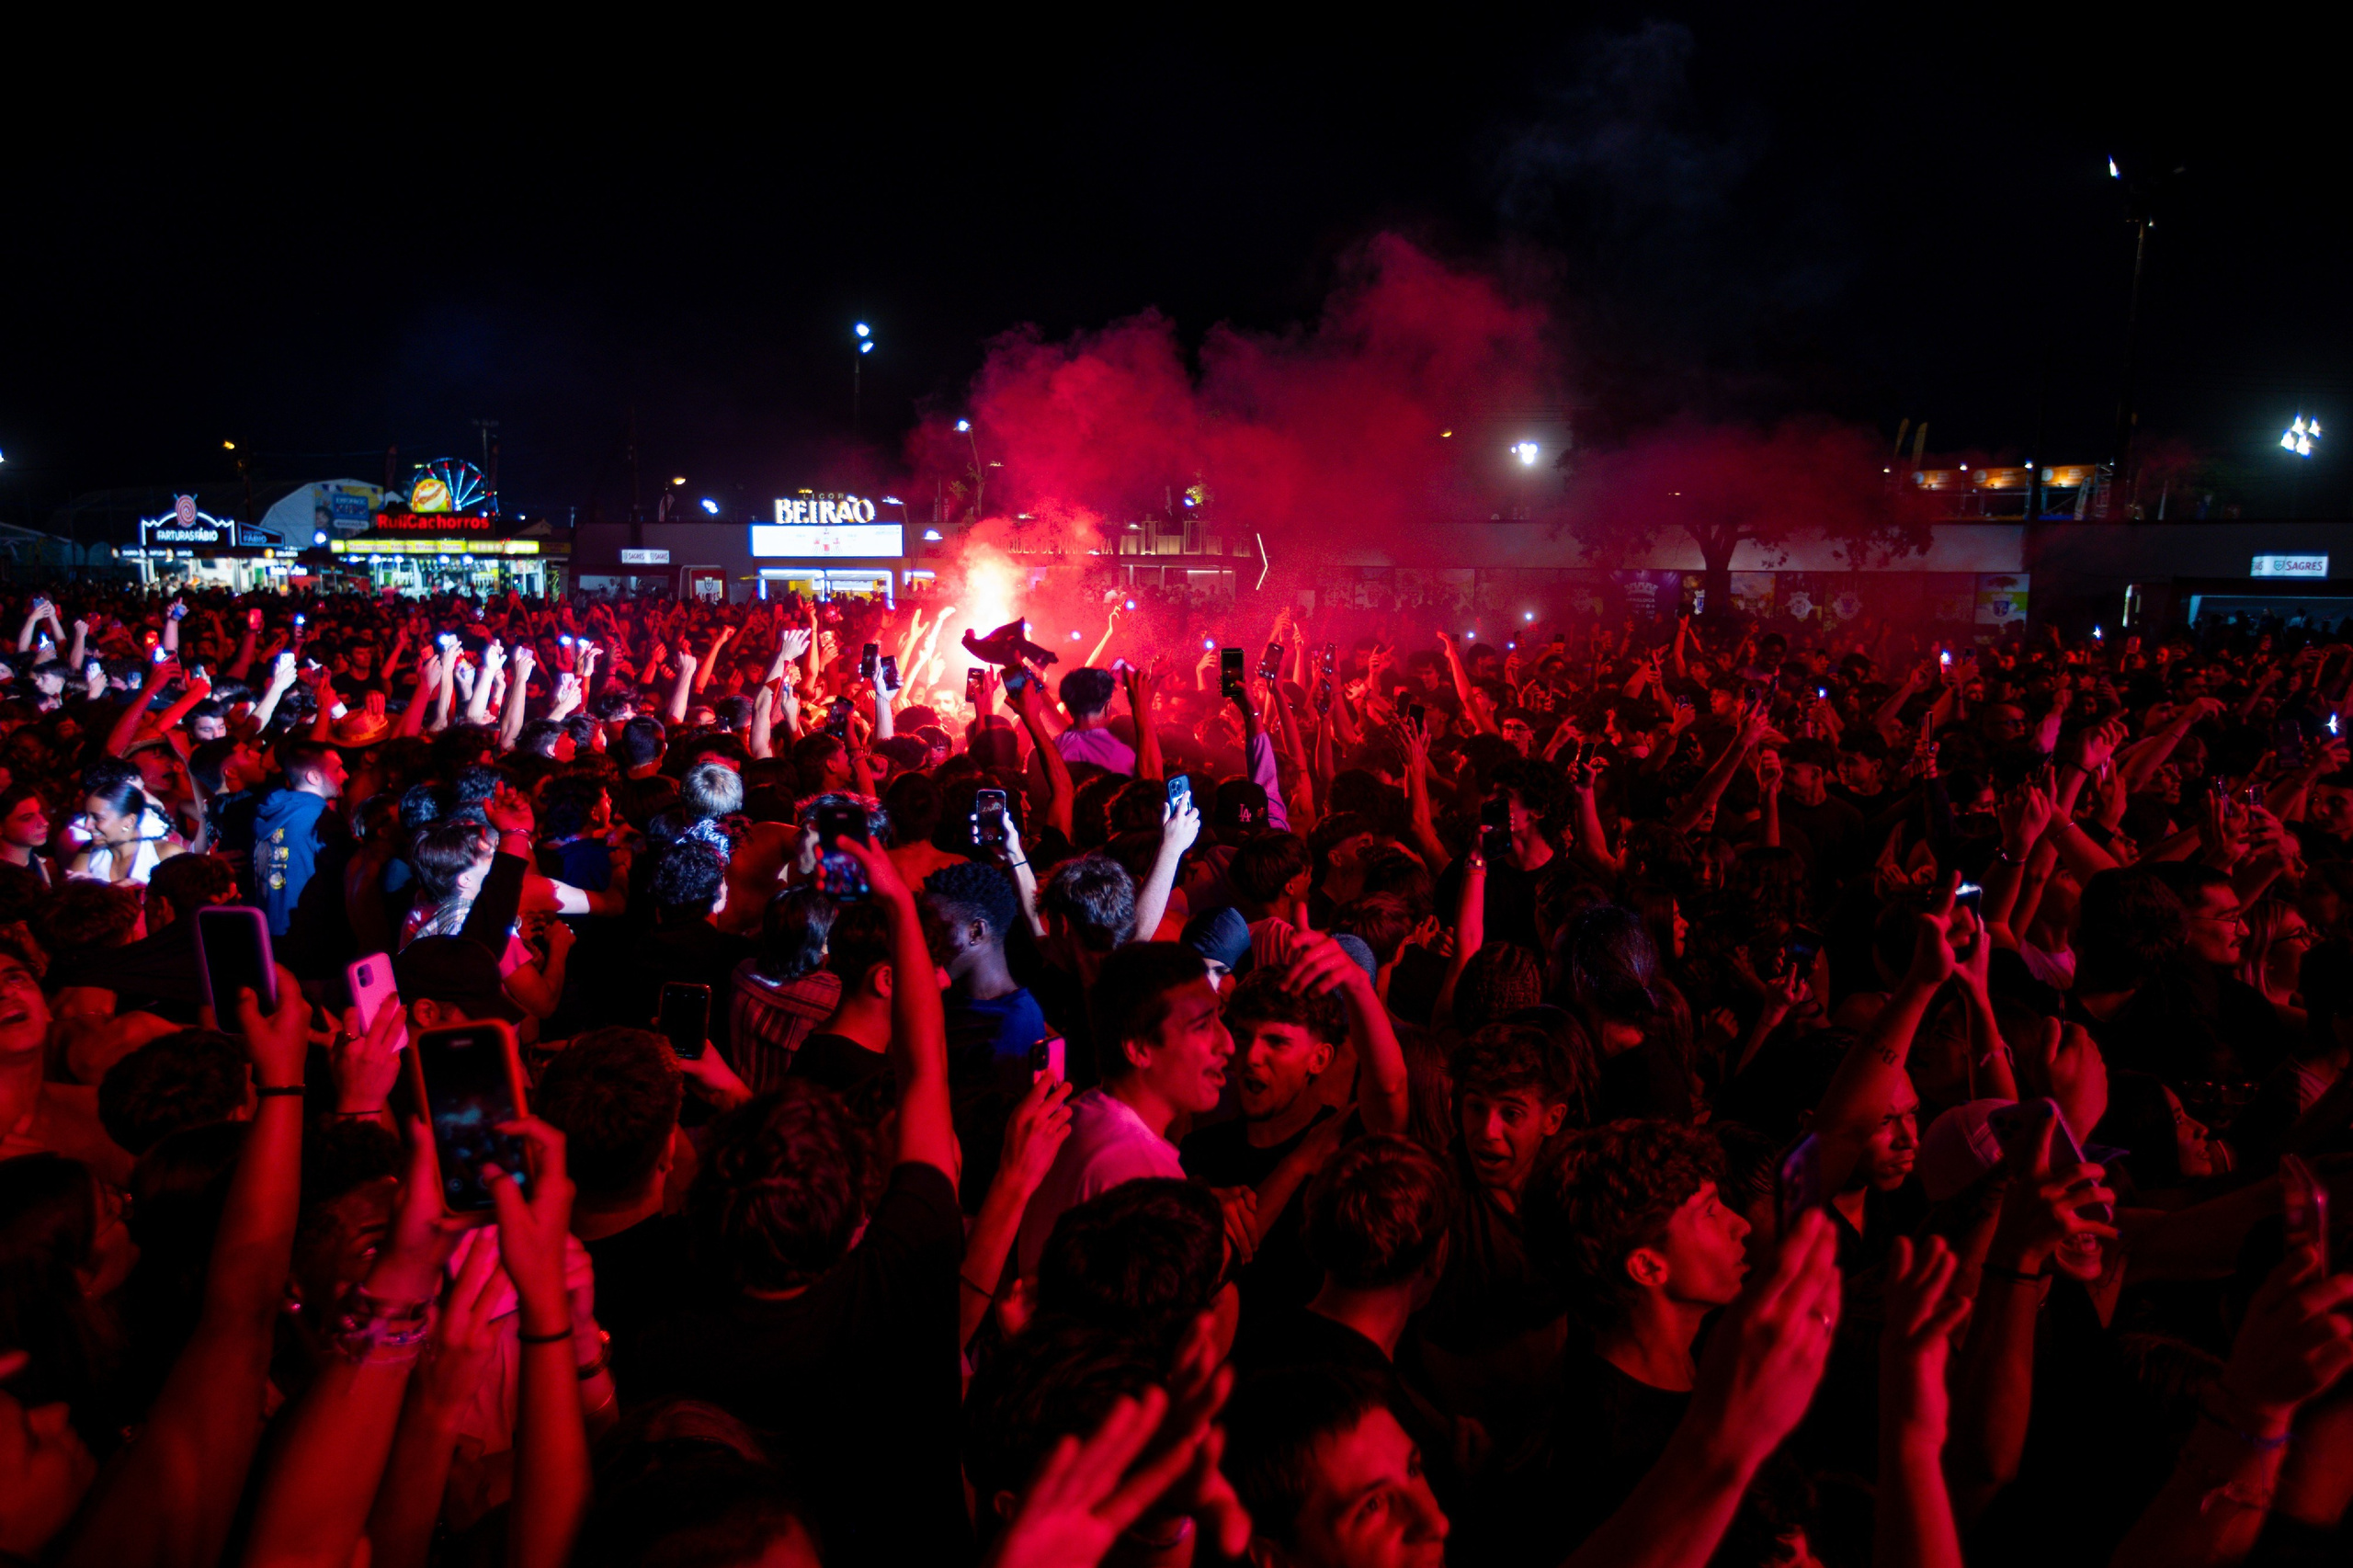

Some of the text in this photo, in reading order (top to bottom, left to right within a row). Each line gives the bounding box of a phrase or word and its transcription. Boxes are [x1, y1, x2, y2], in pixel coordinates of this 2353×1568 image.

[775, 494, 876, 524] BEIRÃO
[2285, 561, 2323, 572] SAGRES
[1238, 803, 1252, 823] LA
